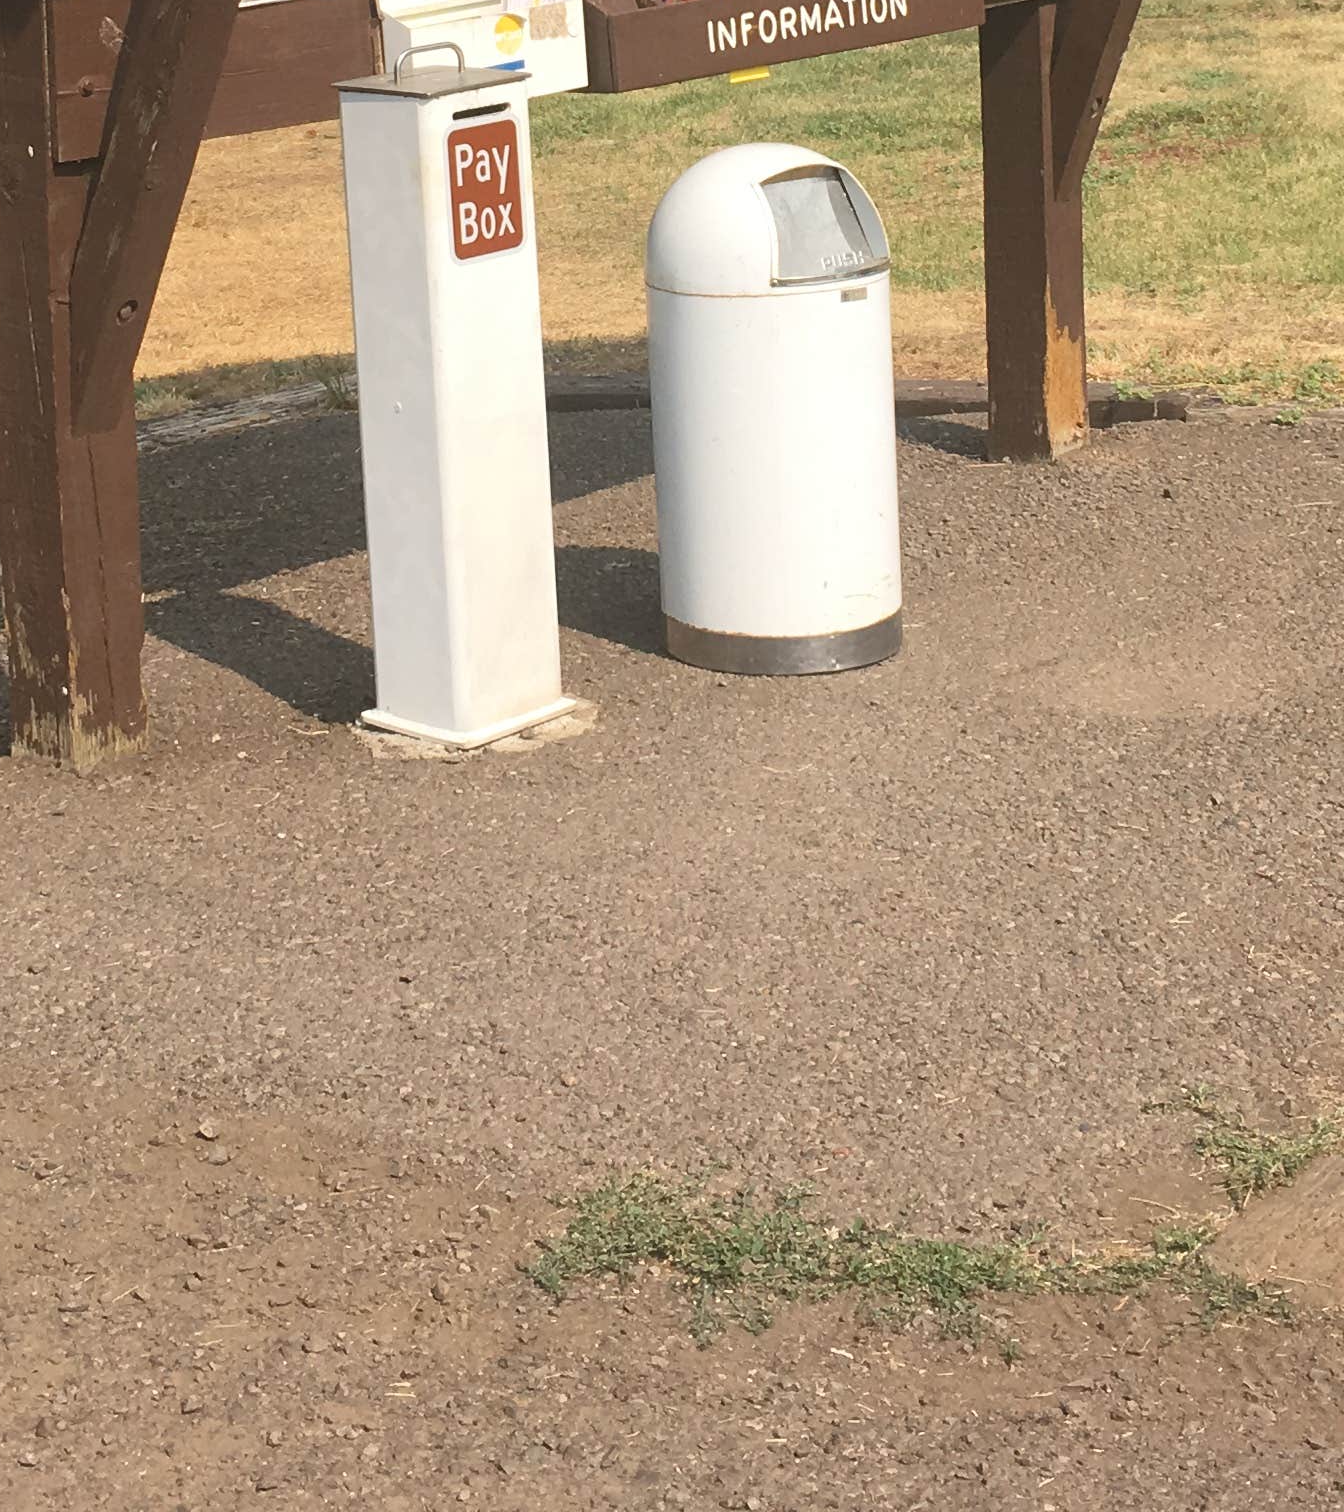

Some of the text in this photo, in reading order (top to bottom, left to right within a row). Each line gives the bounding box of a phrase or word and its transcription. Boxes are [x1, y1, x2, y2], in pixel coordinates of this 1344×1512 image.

[454, 143, 510, 195] Pay
[458, 201, 515, 245] Box
[820, 250, 865, 270] PUSH
